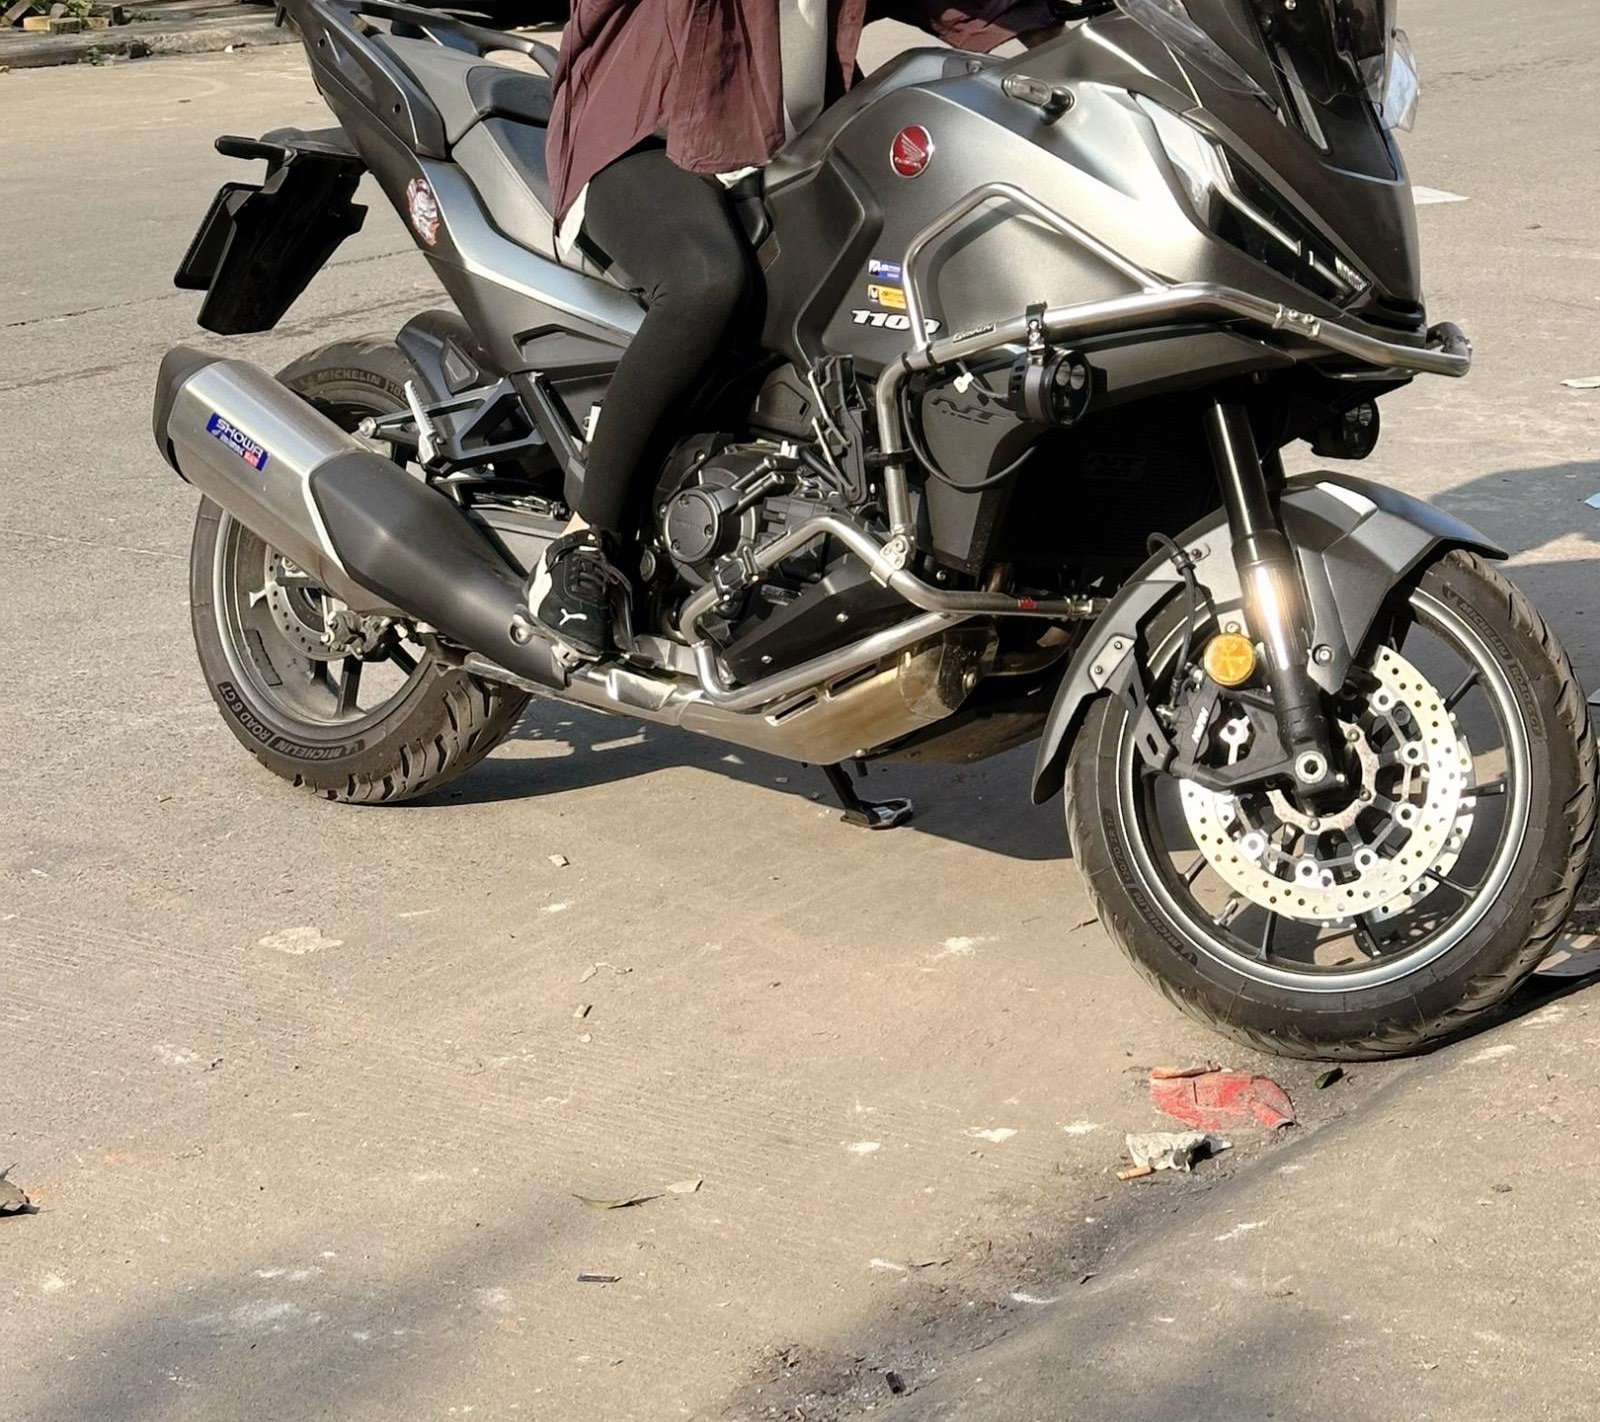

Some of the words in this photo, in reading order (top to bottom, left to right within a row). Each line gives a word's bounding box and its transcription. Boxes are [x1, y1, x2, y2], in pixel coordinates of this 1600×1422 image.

[851, 309, 941, 336] 1100
[316, 368, 382, 386] MICHELIN
[215, 417, 265, 459] SHOWA
[1457, 601, 1510, 659] MICHELIN
[219, 685, 237, 703] GT
[238, 712, 272, 741] ROAD
[275, 738, 345, 760] MICHELIN
[1131, 891, 1186, 955] MICHELIN
